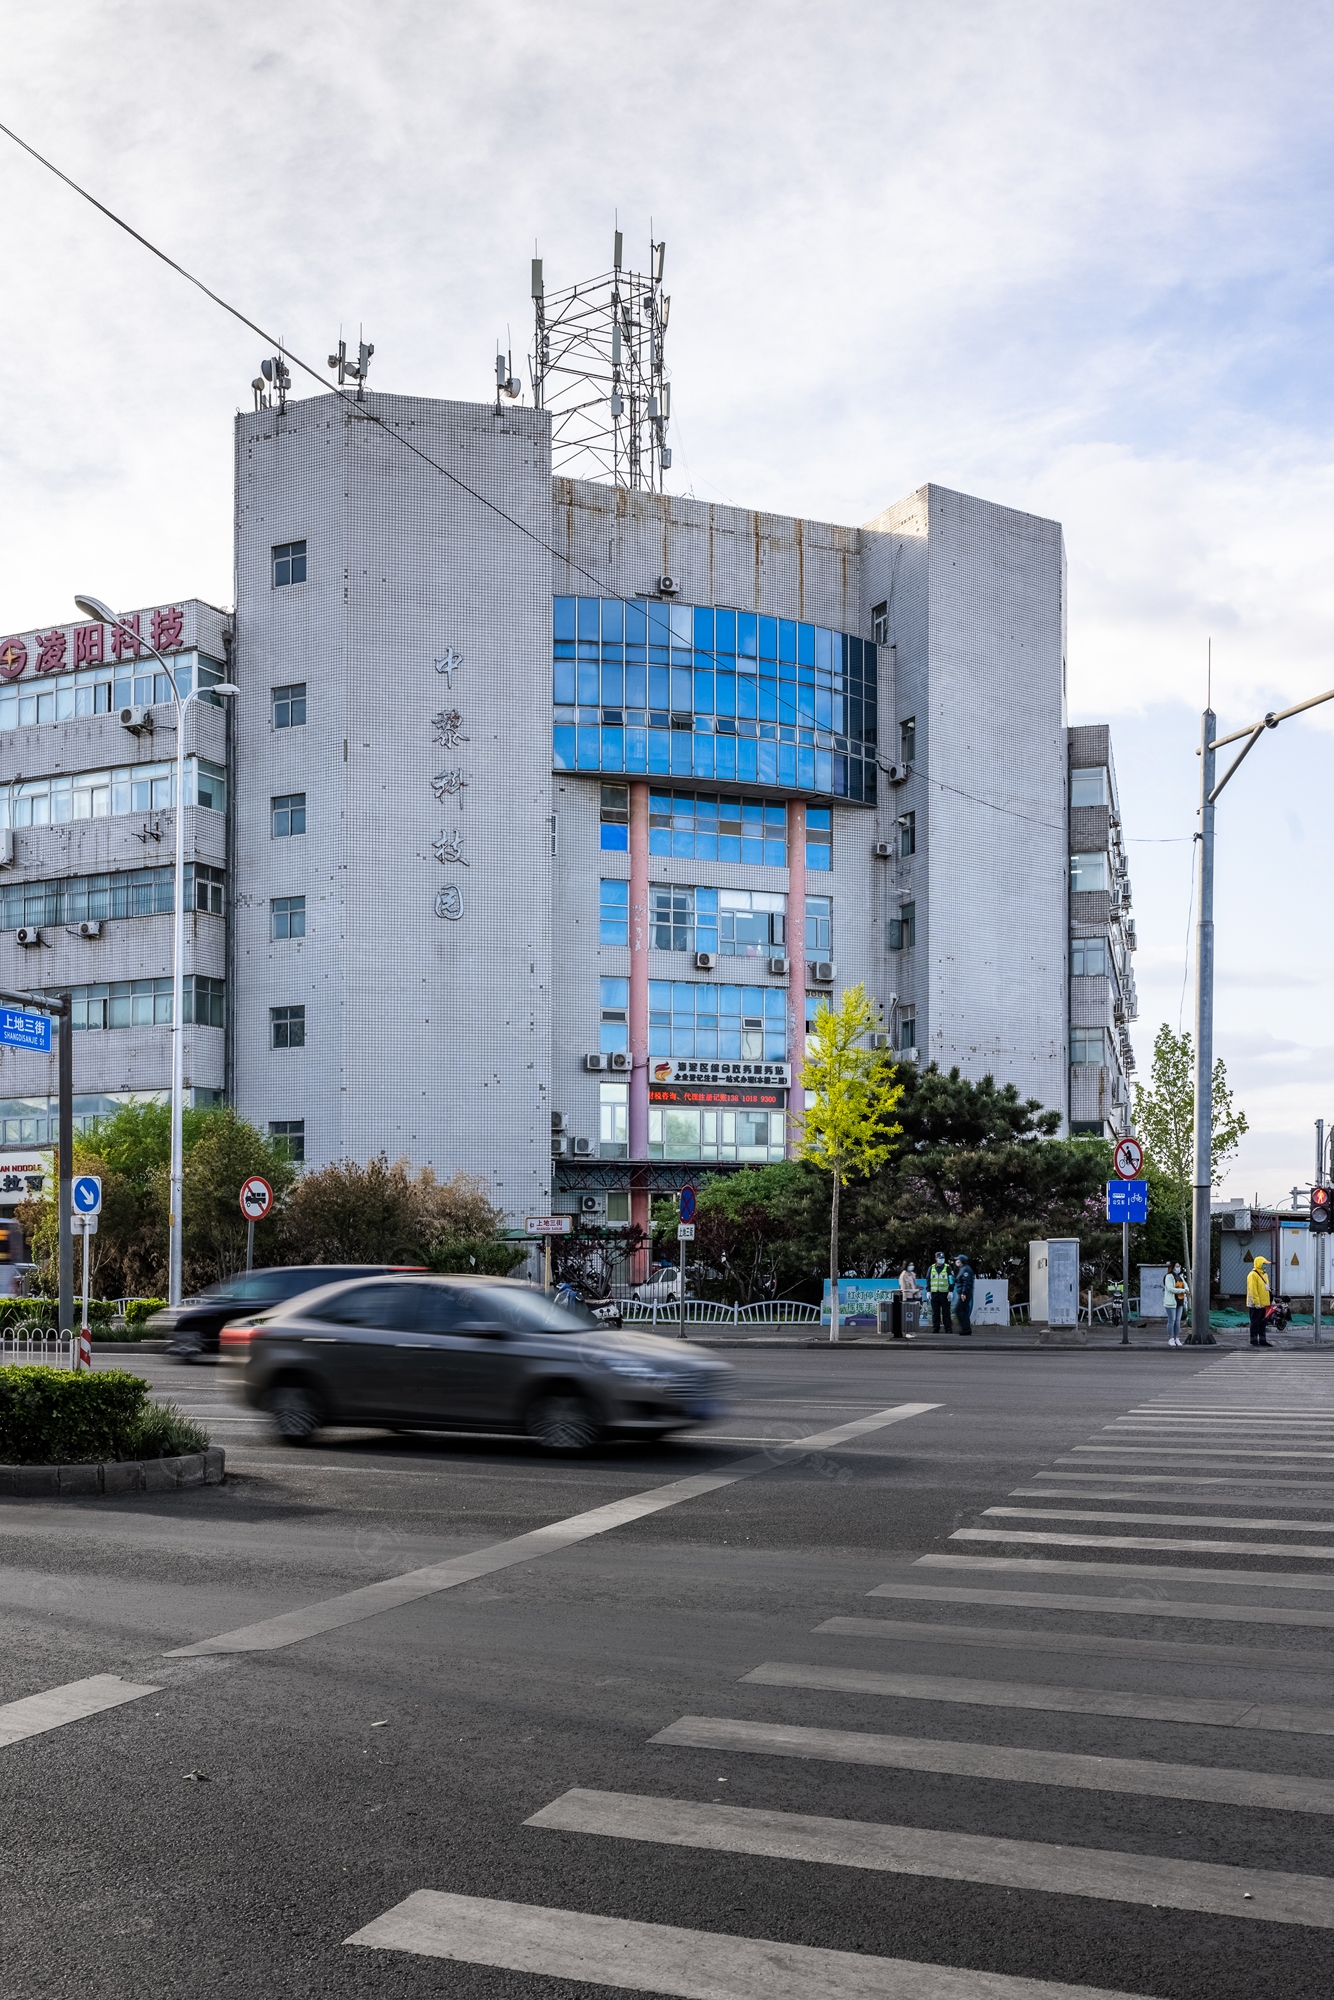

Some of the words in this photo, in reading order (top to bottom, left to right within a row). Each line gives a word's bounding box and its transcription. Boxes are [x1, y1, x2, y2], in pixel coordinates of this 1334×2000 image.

[34, 607, 184, 672] 凌阳科技
[3, 1014, 46, 1036] 上地三街
[678, 1061, 784, 1075] 海淀区综合政务服务站
[760, 1095, 776, 1103] 9300
[12, 1164, 42, 1172] NOODLE
[536, 1219, 563, 1227] 上地三街
[847, 1291, 874, 1300] 红灯停
